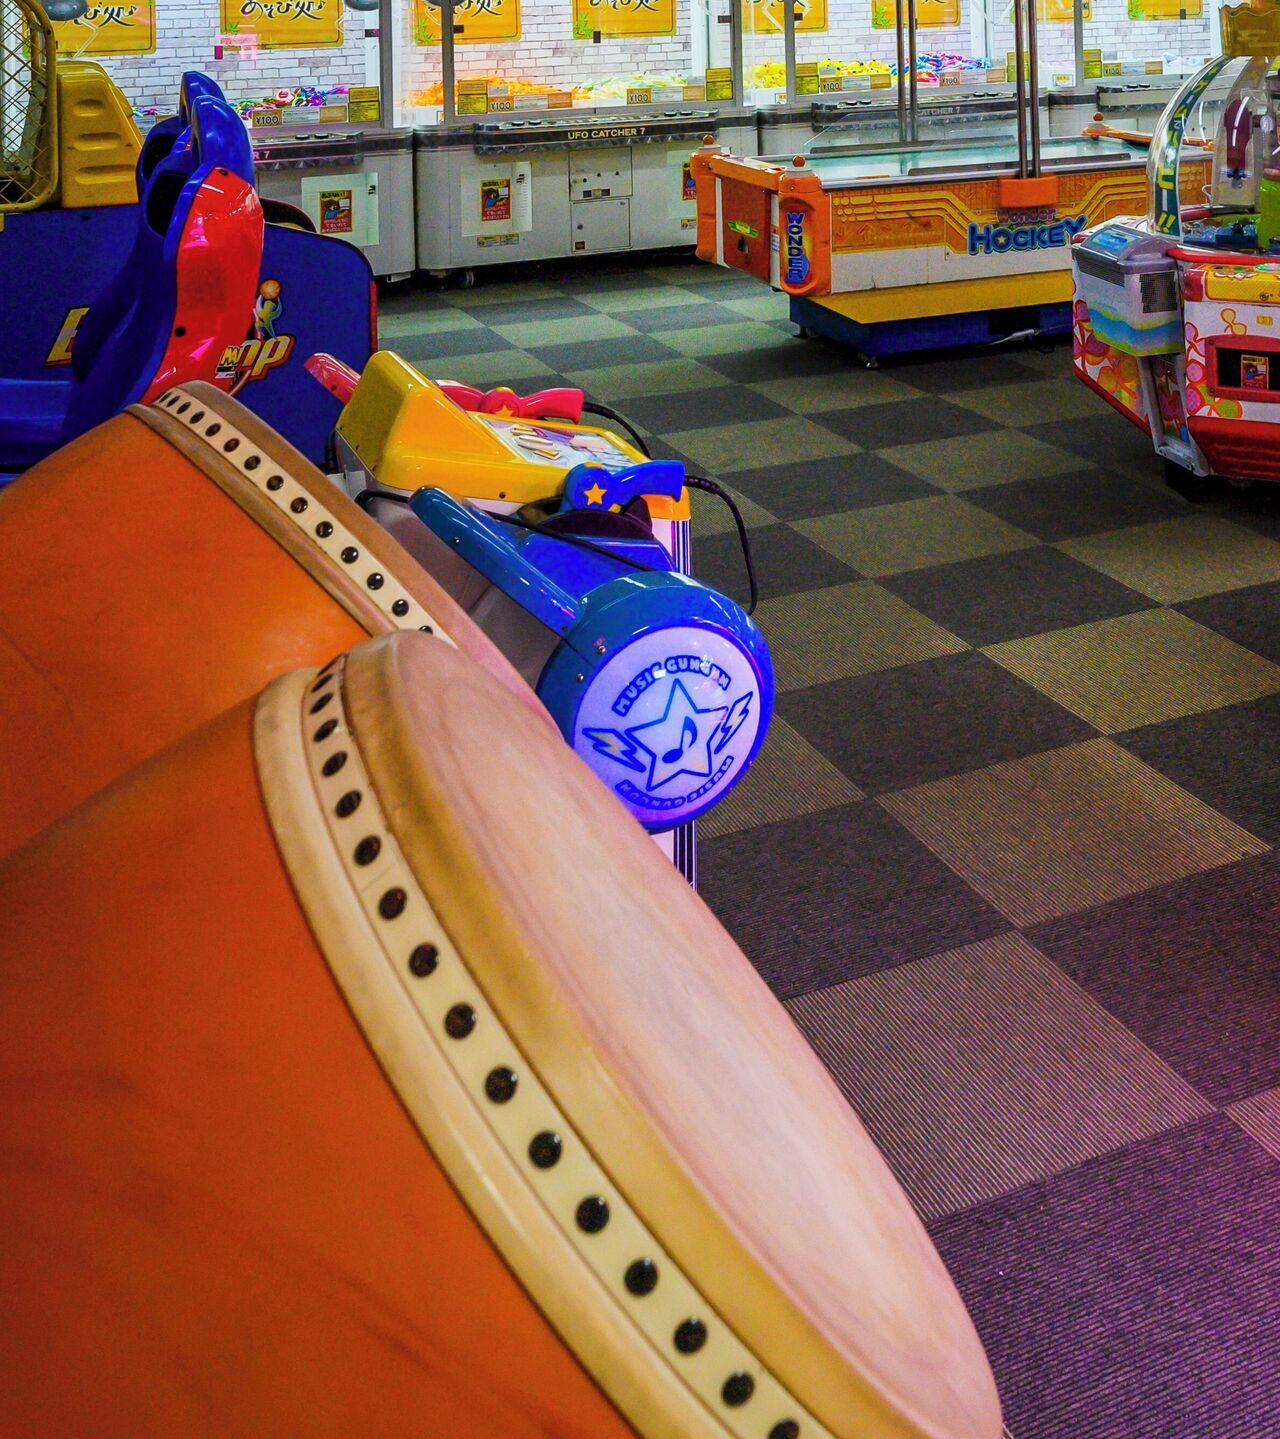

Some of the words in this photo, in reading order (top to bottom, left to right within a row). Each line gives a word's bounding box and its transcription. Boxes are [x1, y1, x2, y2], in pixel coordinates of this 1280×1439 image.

[255, 115, 279, 125] ¥100
[567, 130, 589, 141] UFO
[591, 128, 637, 140] CATCHER
[639, 127, 646, 136] 7
[263, 150, 270, 159] 7
[996, 206, 1056, 224] Wonder
[967, 214, 1088, 256] HOCKEY
[785, 211, 808, 284] WONDER
[612, 661, 668, 717] MUSIC
